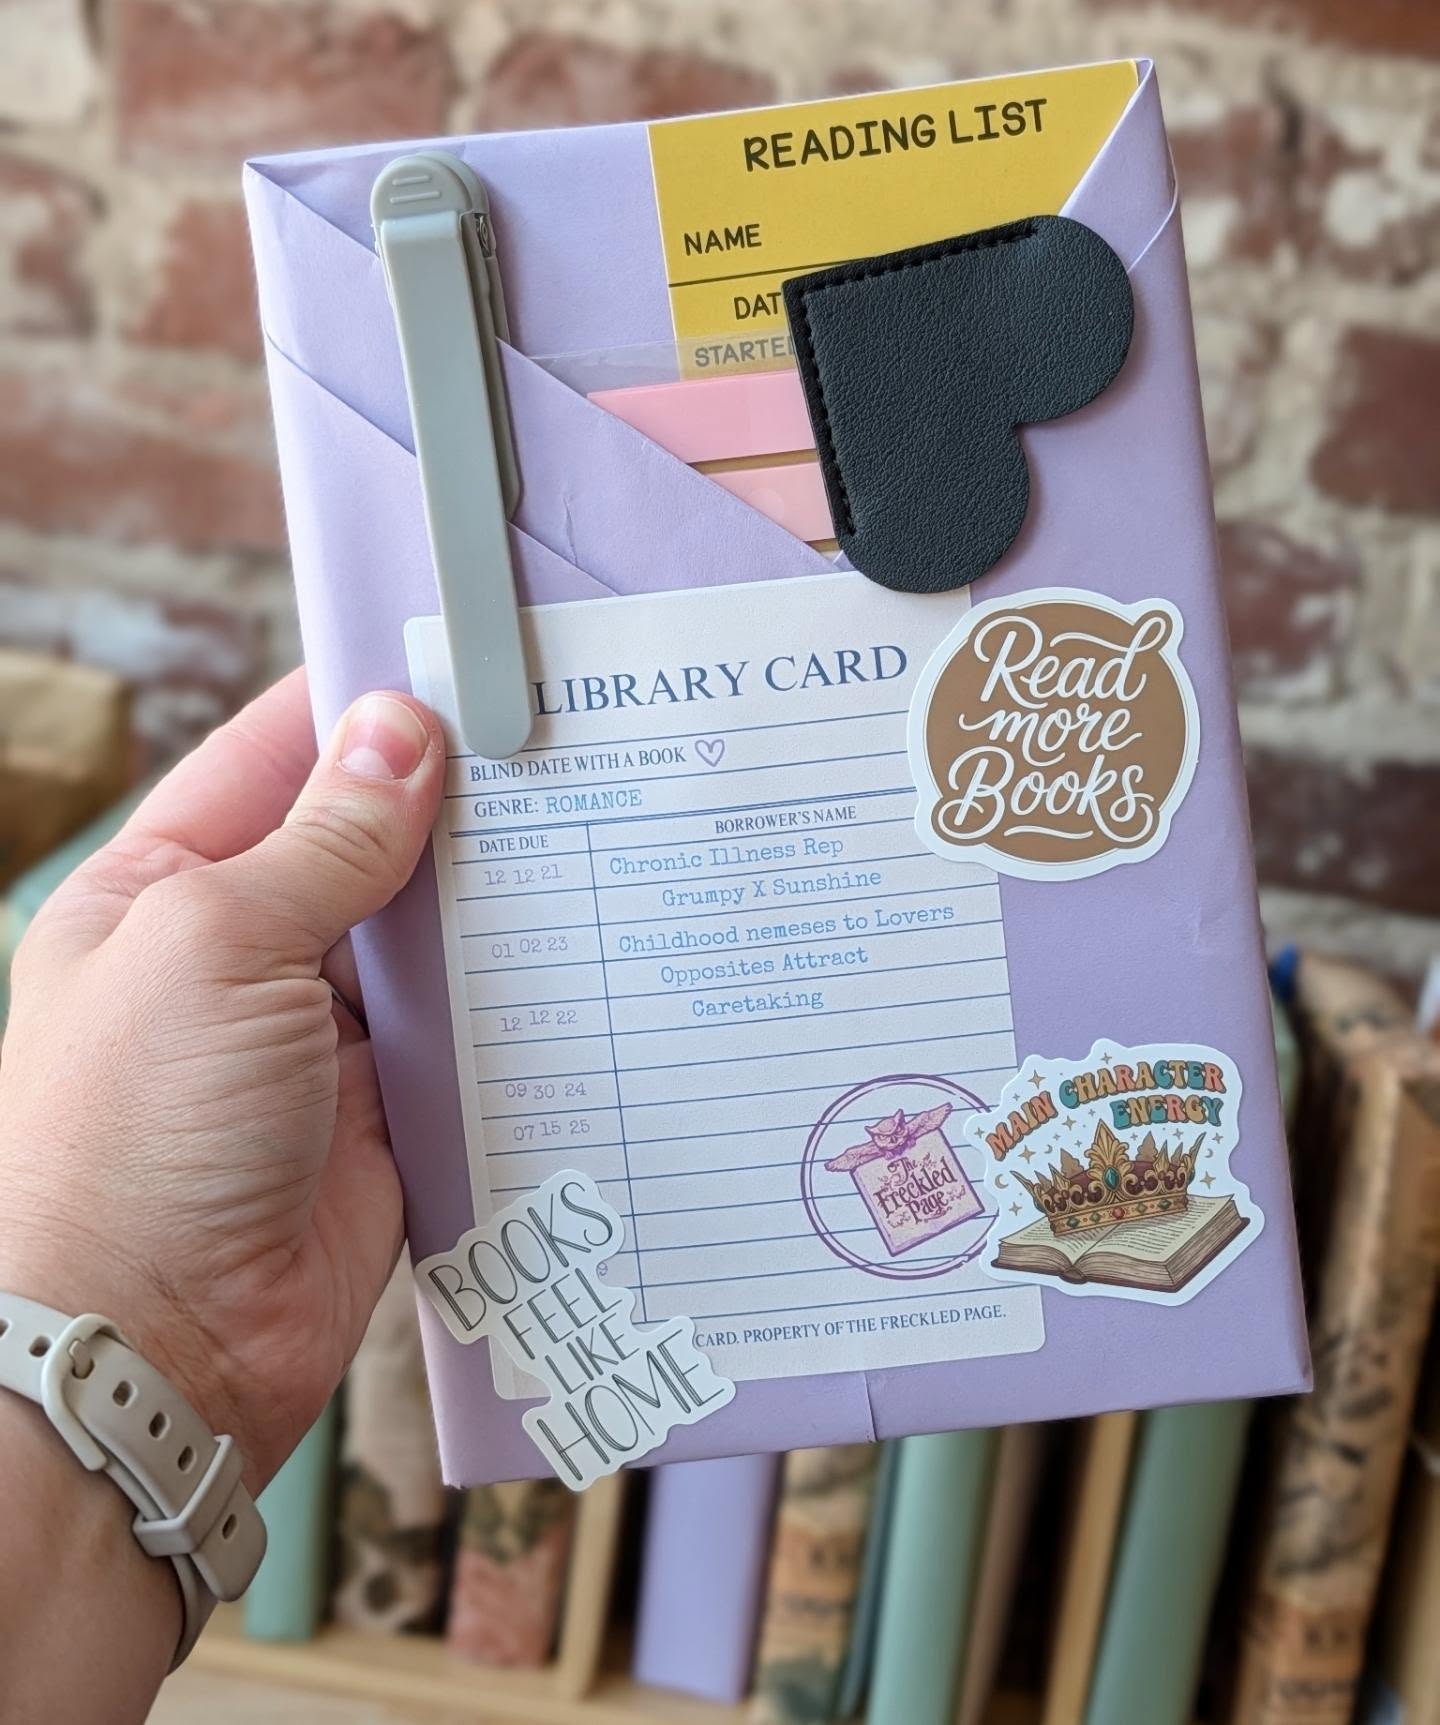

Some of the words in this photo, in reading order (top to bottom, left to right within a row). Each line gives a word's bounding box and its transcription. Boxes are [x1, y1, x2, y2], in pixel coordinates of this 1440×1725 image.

[743, 113, 936, 172] READING
[949, 97, 1048, 144] LIST
[684, 223, 763, 256] NAME
[733, 291, 781, 320] DAT
[534, 660, 751, 717] LIBRARY
[764, 644, 908, 692] CARD
[973, 615, 1167, 710] Read
[958, 702, 1143, 767] more
[470, 761, 523, 782] BLIND
[527, 757, 572, 777] DATE
[570, 753, 620, 772] WITH
[622, 751, 634, 768] A
[638, 746, 687, 767] BOOK
[474, 797, 539, 818] GENRE:
[546, 788, 642, 814] ROMANCE
[937, 745, 1155, 843] Books
[714, 809, 812, 835] BORROWER'S
[812, 805, 857, 824] NAME
[479, 836, 515, 854] DATE
[518, 834, 549, 851] DUE
[609, 851, 703, 876] Chronic
[708, 842, 797, 867] Illness
[802, 835, 845, 858] Rep
[484, 869, 506, 887] 12
[512, 869, 535, 886] 12
[540, 863, 563, 880] 21
[661, 883, 746, 908] Grumpy
[752, 879, 769, 899] X
[772, 869, 883, 897] Sunshine
[491, 943, 514, 959] 01
[519, 937, 542, 954] 02
[546, 935, 569, 952] 23
[618, 924, 741, 953] Childhood
[745, 916, 837, 943] nemeses
[843, 912, 869, 932] to
[874, 904, 955, 928] Lovers
[660, 956, 775, 985] Opposites
[781, 945, 869, 972] Attract
[500, 1016, 522, 1033] 12
[529, 1009, 550, 1026] 12
[555, 1009, 578, 1025] 22
[692, 990, 825, 1018] Caretaking
[504, 1081, 528, 1099] 09
[533, 1083, 556, 1100] 30
[564, 1081, 588, 1098] 24
[985, 1090, 1059, 1161] MAIN
[1058, 1059, 1227, 1110] CHARACTER
[513, 1124, 534, 1142] 07
[541, 1120, 562, 1137] 15
[569, 1119, 591, 1135] 25
[1109, 1093, 1224, 1130] ENERGY
[872, 1155, 958, 1219] Freckled
[886, 1156, 918, 1187] The
[905, 1190, 949, 1225] Page
[427, 1180, 613, 1332] BOOKS
[502, 1267, 623, 1361] FEEL
[695, 1331, 740, 1349] CARD.
[743, 1323, 820, 1344] PROPERTY
[824, 1321, 843, 1337] OF
[845, 1318, 878, 1335] THE
[880, 1309, 961, 1331] FRECKLED
[964, 1304, 1007, 1323] PAGE.
[544, 1311, 640, 1395] LIKE
[535, 1328, 725, 1482] HOME
